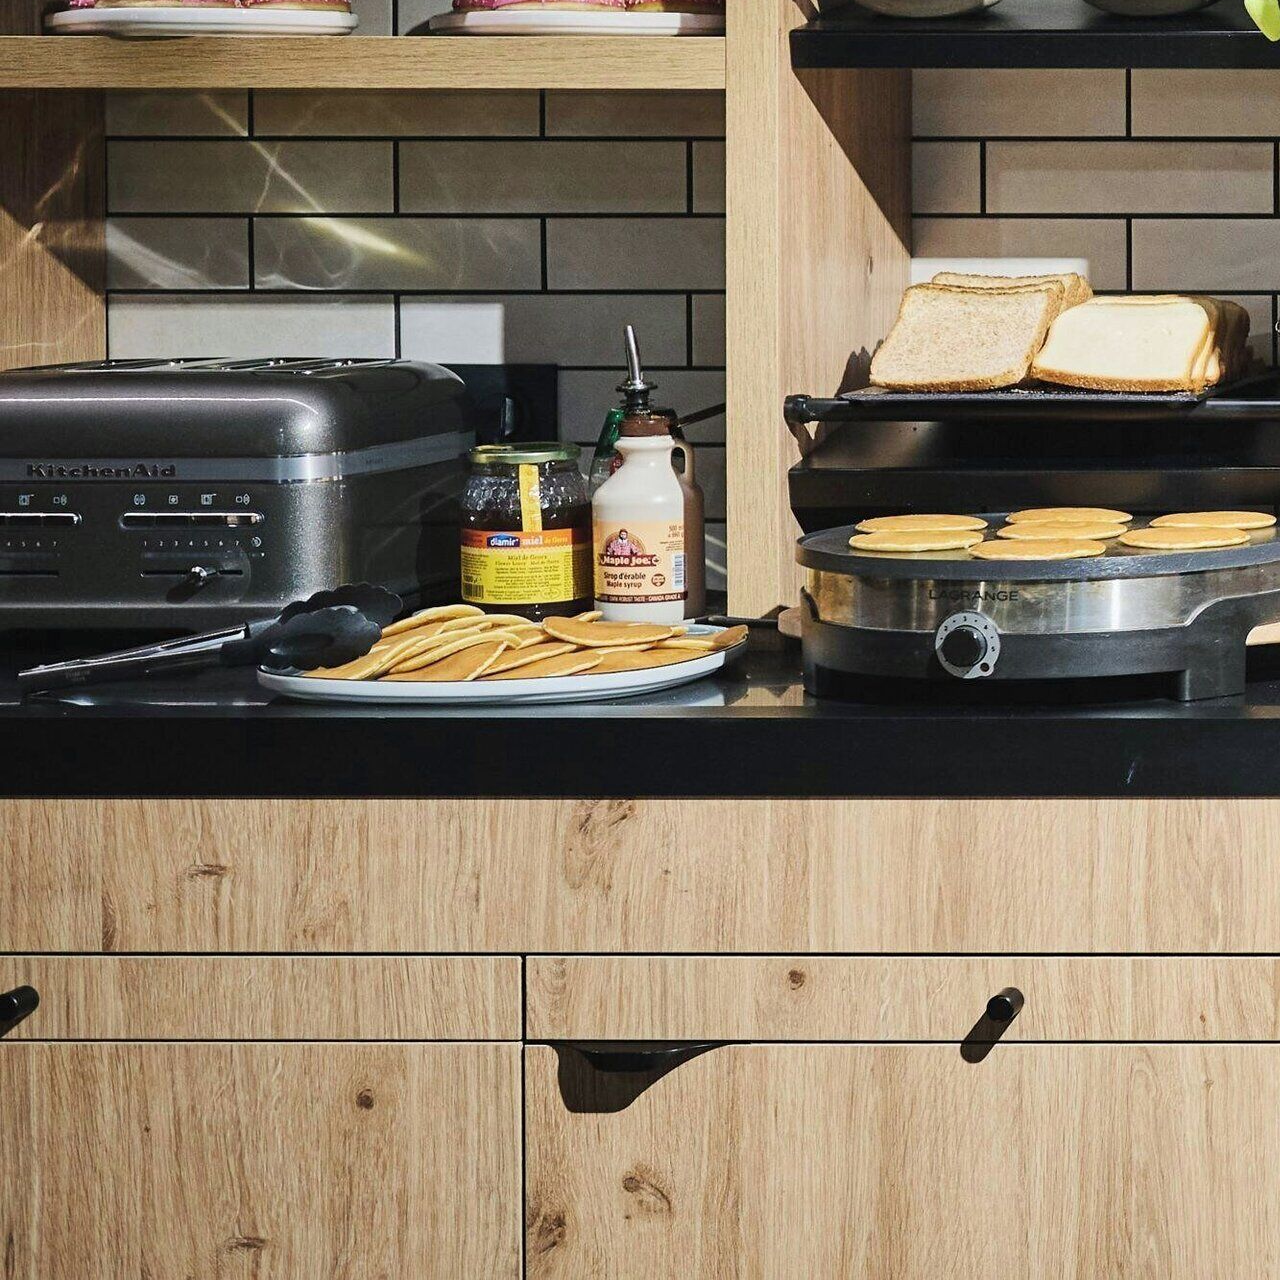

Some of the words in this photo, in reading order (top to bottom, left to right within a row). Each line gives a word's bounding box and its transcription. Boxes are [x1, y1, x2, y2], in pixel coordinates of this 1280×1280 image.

[27, 463, 176, 478] KitchenAid
[523, 535, 544, 546] miel
[601, 555, 629, 566] Maple
[604, 572, 618, 581] Sirop
[619, 572, 646, 580] d'érable
[606, 580, 623, 588] Maple
[929, 590, 1019, 601] LAGRANGE
